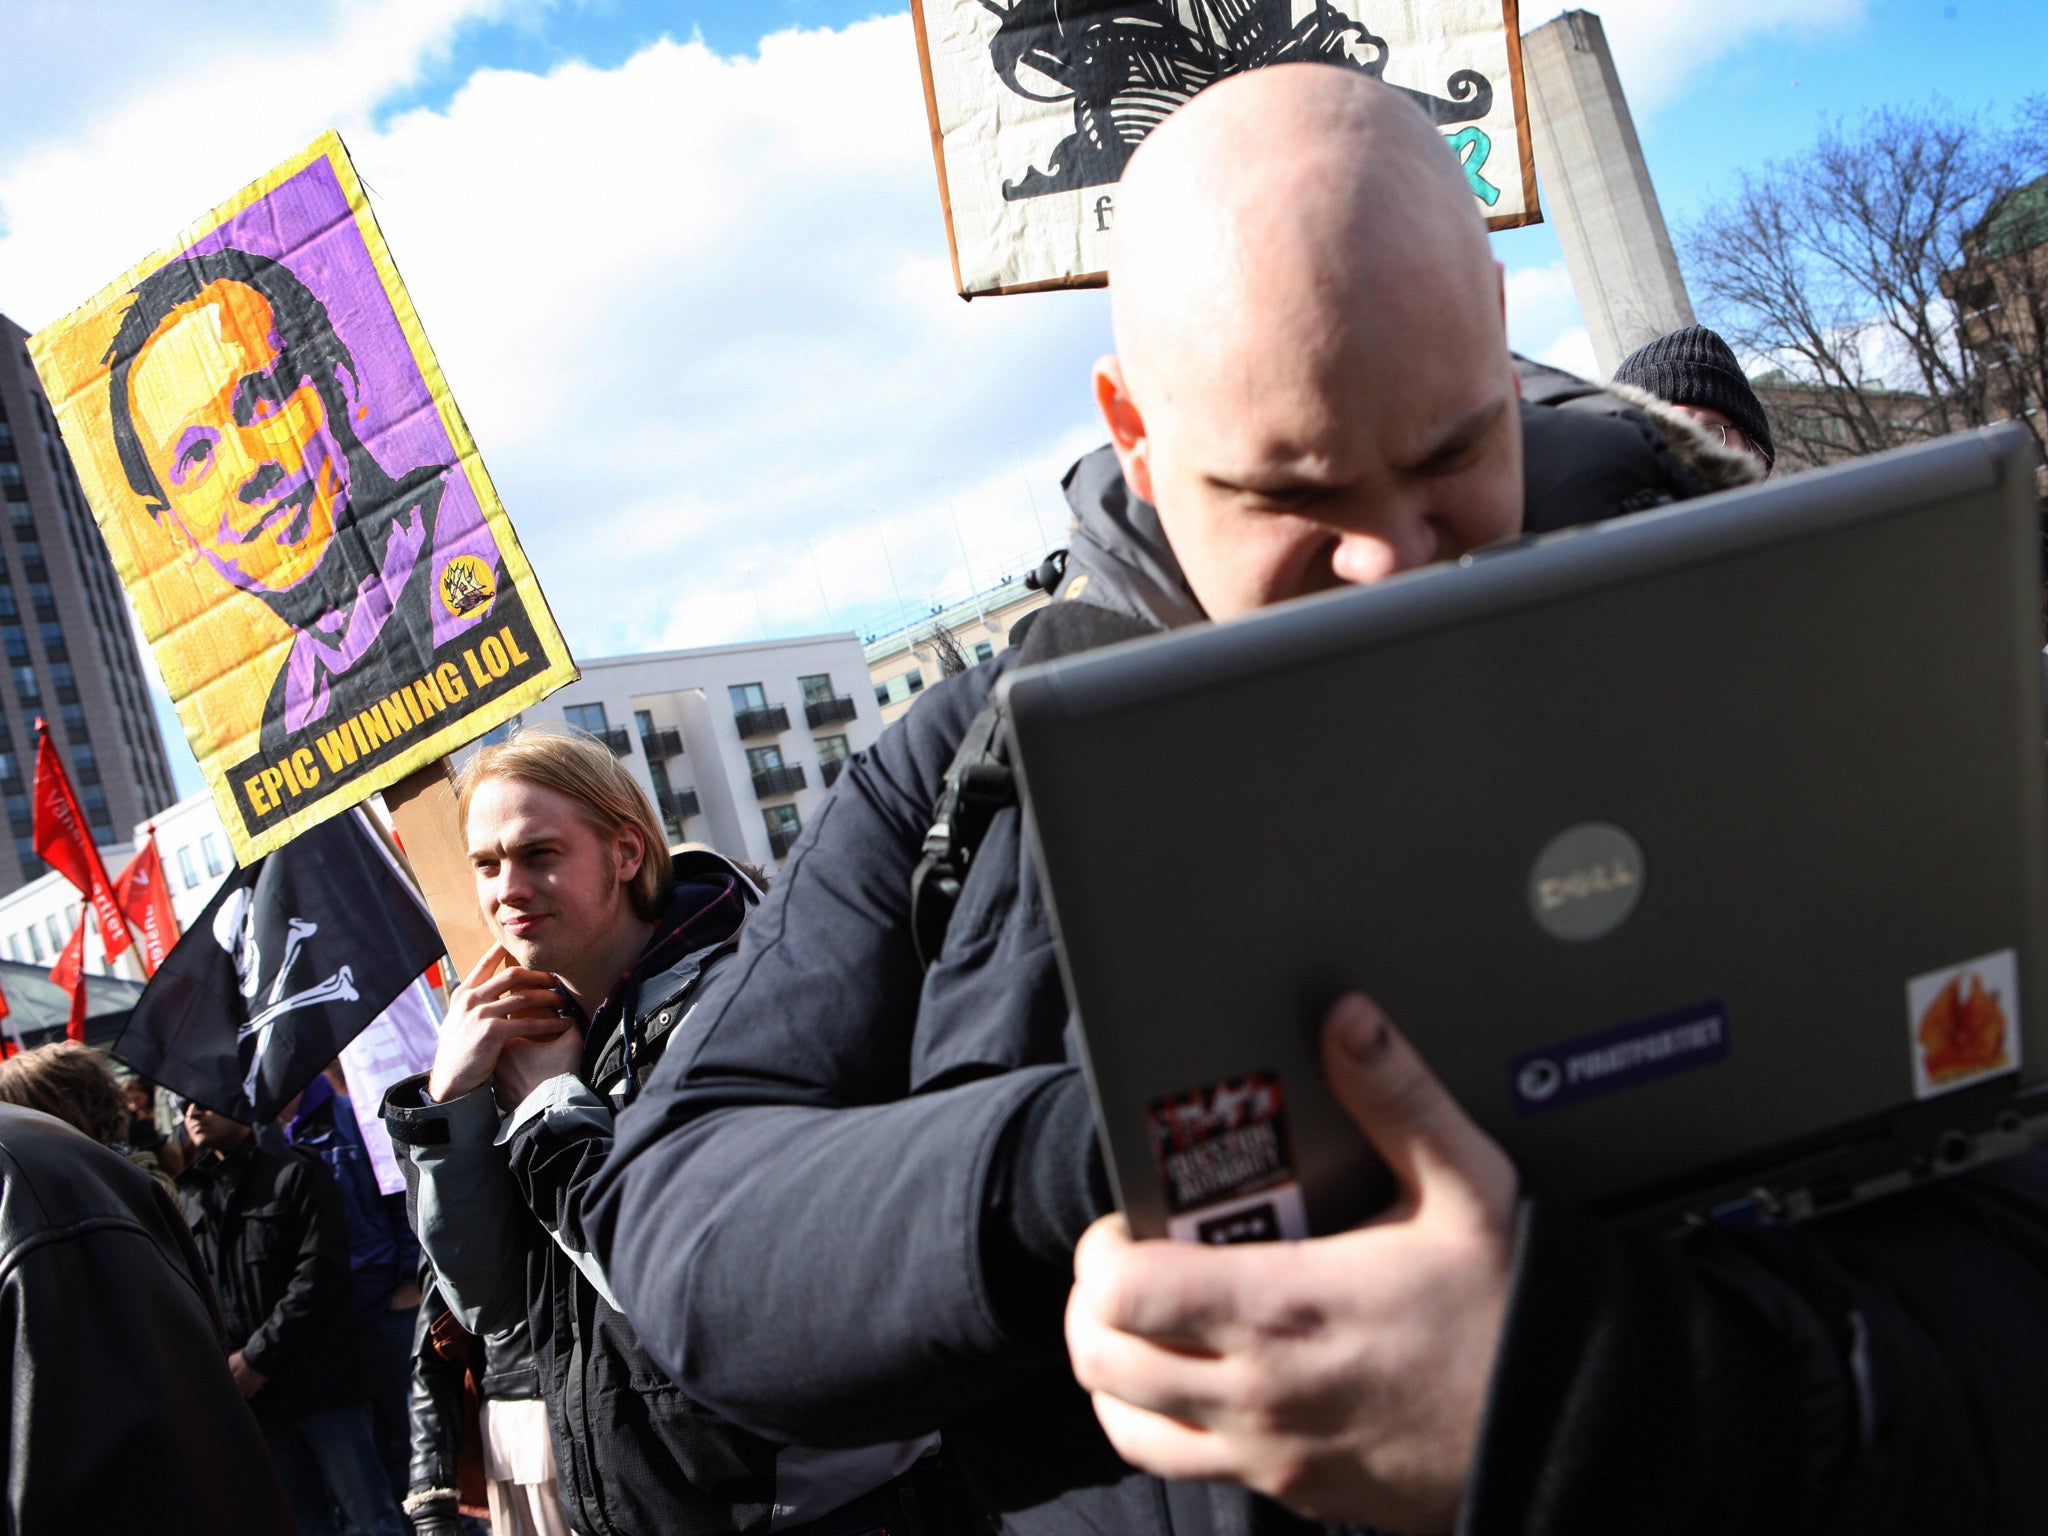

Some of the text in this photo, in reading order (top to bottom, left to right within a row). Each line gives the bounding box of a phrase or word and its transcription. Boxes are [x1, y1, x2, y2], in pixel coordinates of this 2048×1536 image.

[243, 625, 530, 817] EPIC WINNING LOL
